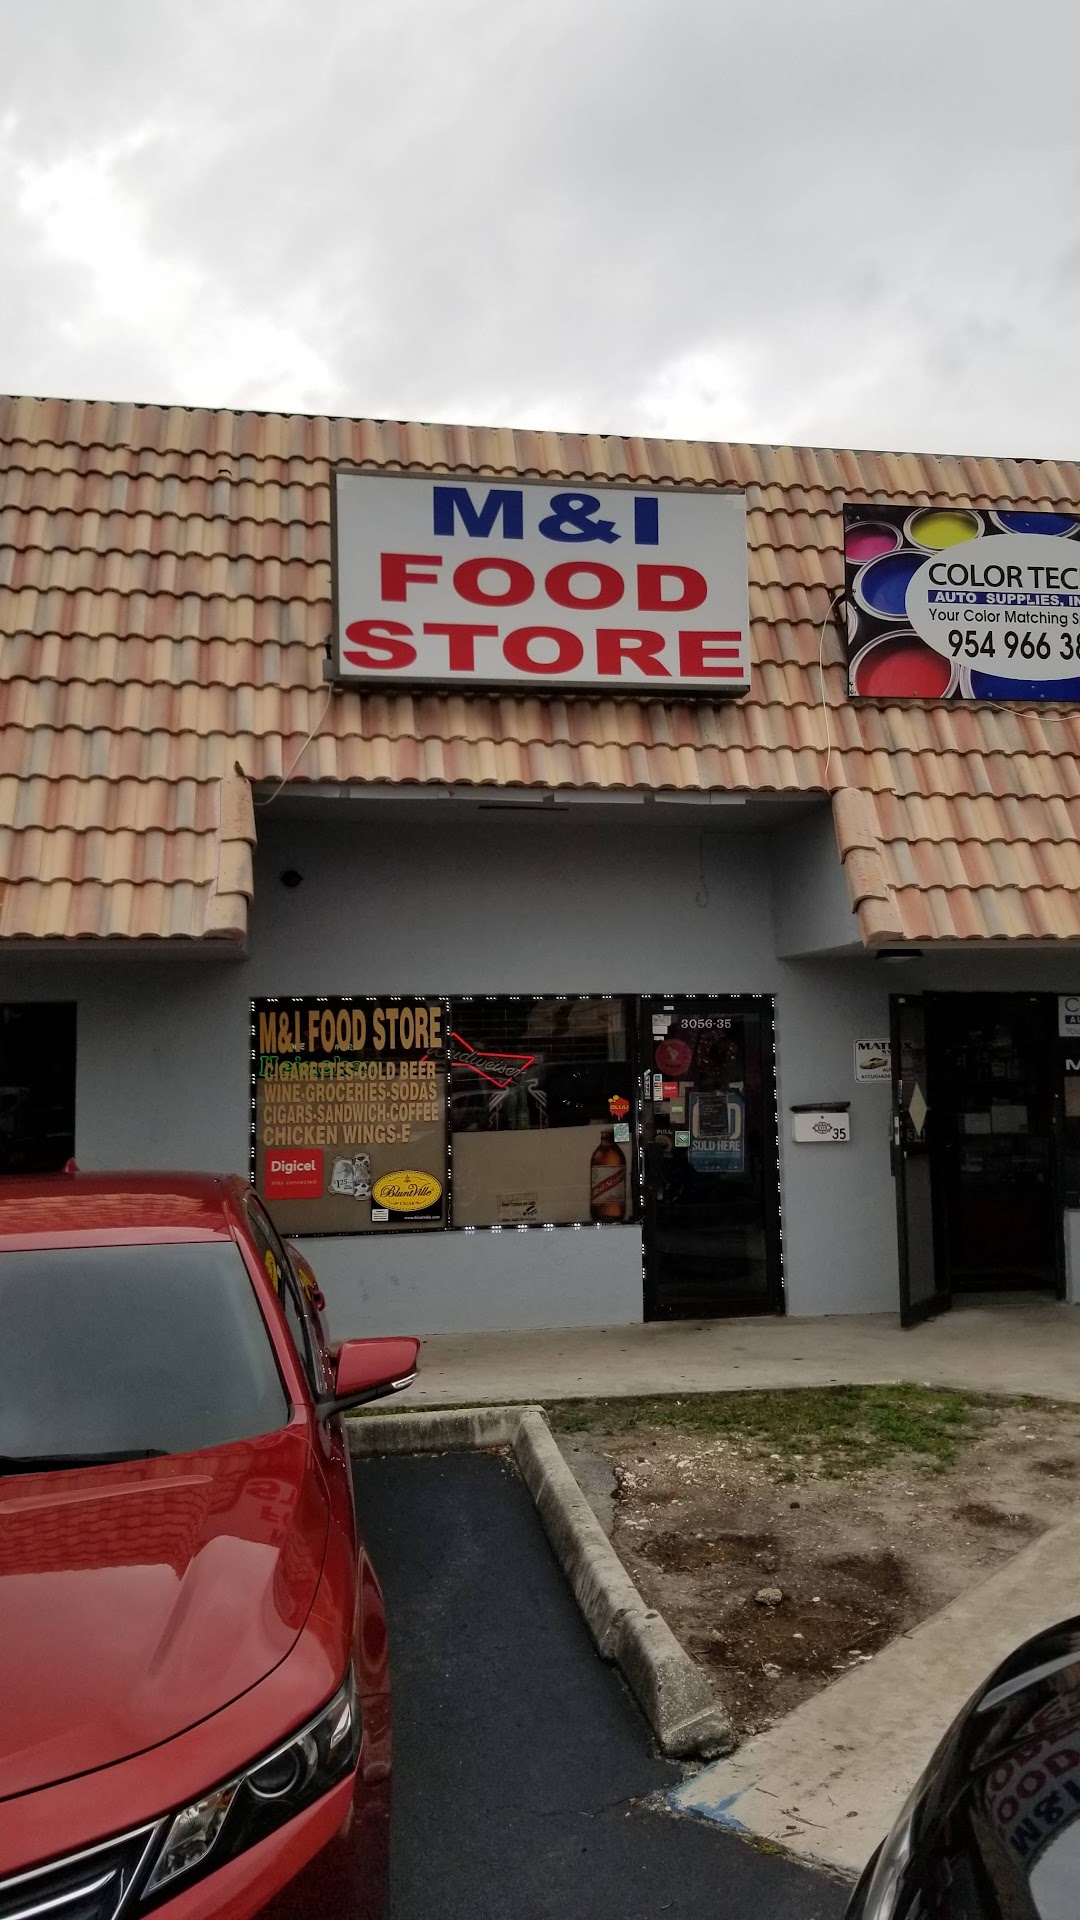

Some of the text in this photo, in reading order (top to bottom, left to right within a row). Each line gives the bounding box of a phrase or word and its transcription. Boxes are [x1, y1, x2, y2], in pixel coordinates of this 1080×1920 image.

[433, 486, 659, 545] M&I
[380, 552, 708, 612] FOOD
[928, 563, 1024, 588] COLOR
[935, 591, 977, 603] AUTO
[986, 593, 1065, 607] SUPPLIES,
[928, 608, 960, 621] Your
[963, 609, 1001, 622] Color
[1005, 611, 1068, 627] Matching
[343, 620, 744, 678] STORE
[948, 629, 1080, 660] 954 966 3
[259, 1006, 443, 1054] M&I FOOD STORE
[681, 1018, 731, 1029] 3056-35
[400, 1060, 436, 1080] BEER
[263, 1125, 338, 1146] CHICKEN
[832, 1127, 847, 1140] 35
[692, 1140, 740, 1152] SOLD HERE
[271, 1160, 317, 1174] Digicel
